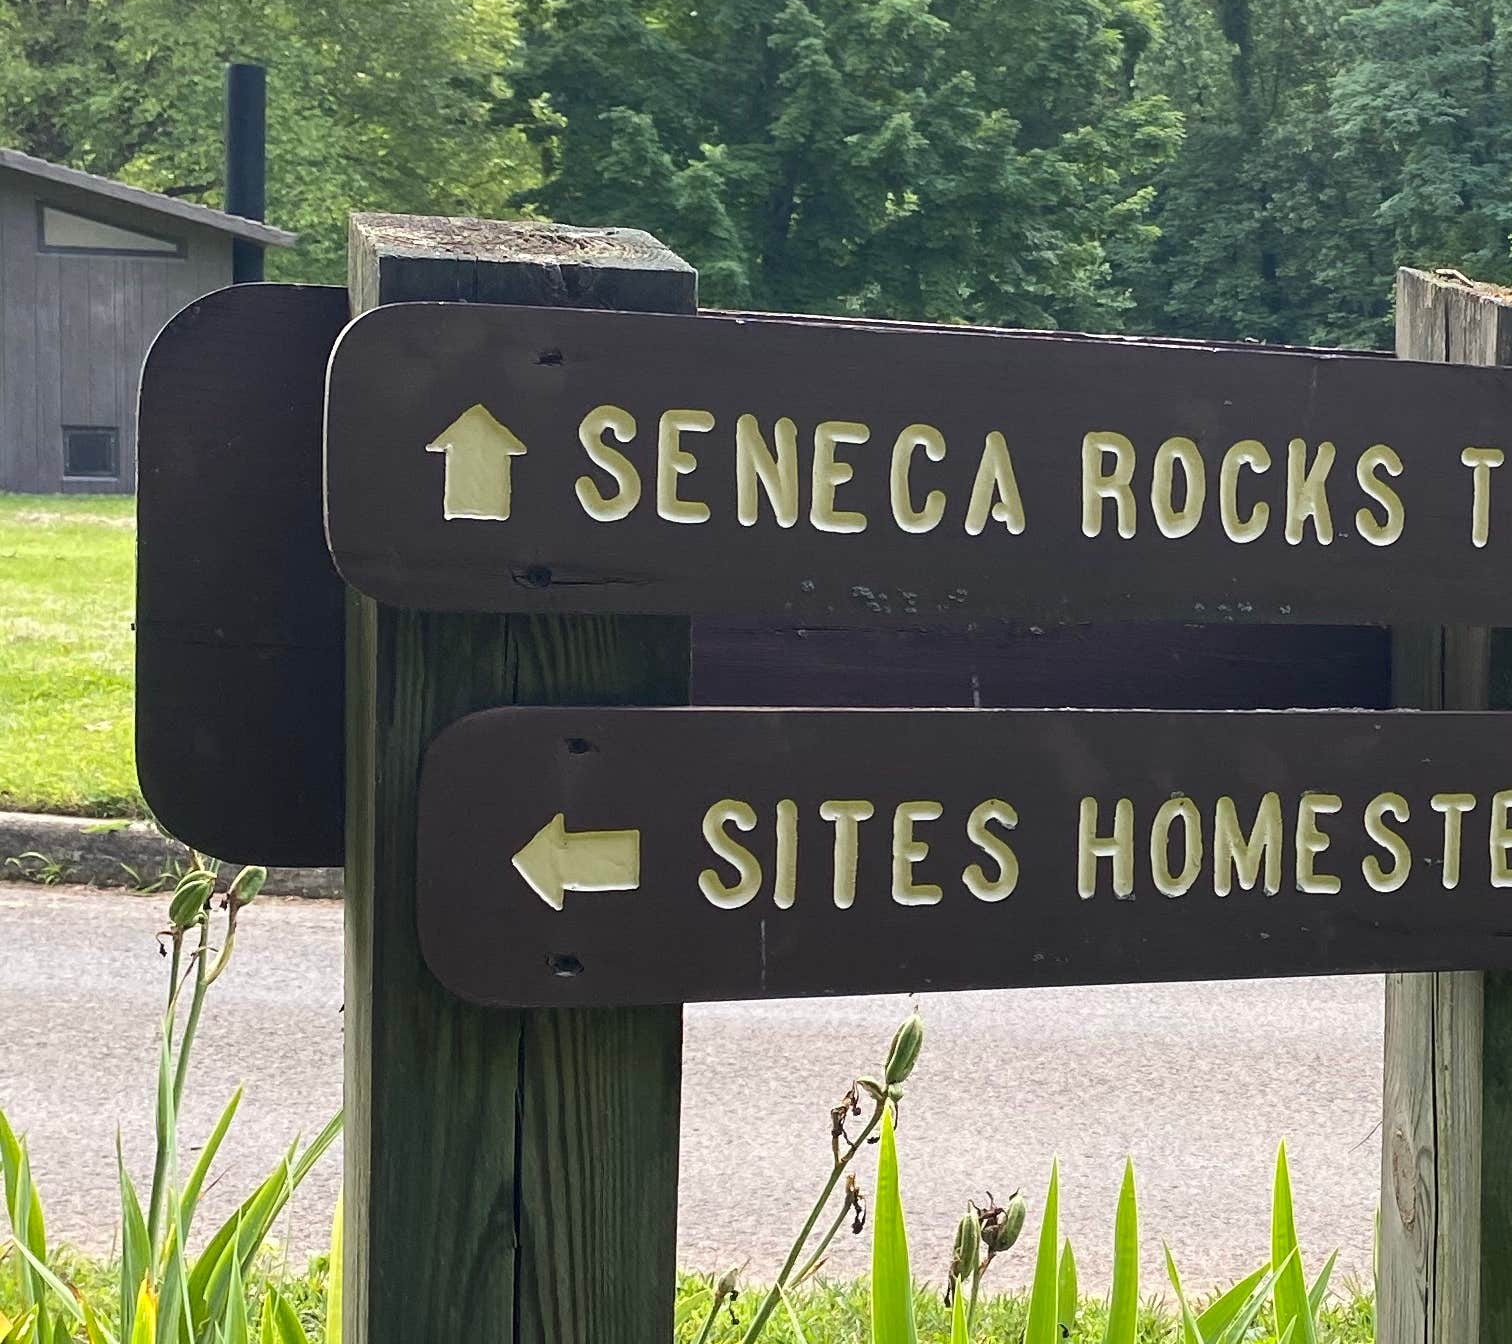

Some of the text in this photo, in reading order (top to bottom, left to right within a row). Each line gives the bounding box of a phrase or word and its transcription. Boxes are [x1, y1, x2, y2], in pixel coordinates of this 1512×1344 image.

[575, 404, 1026, 536] SENECA
[1081, 431, 1405, 547] ROCKS
[698, 797, 1020, 910] SITES
